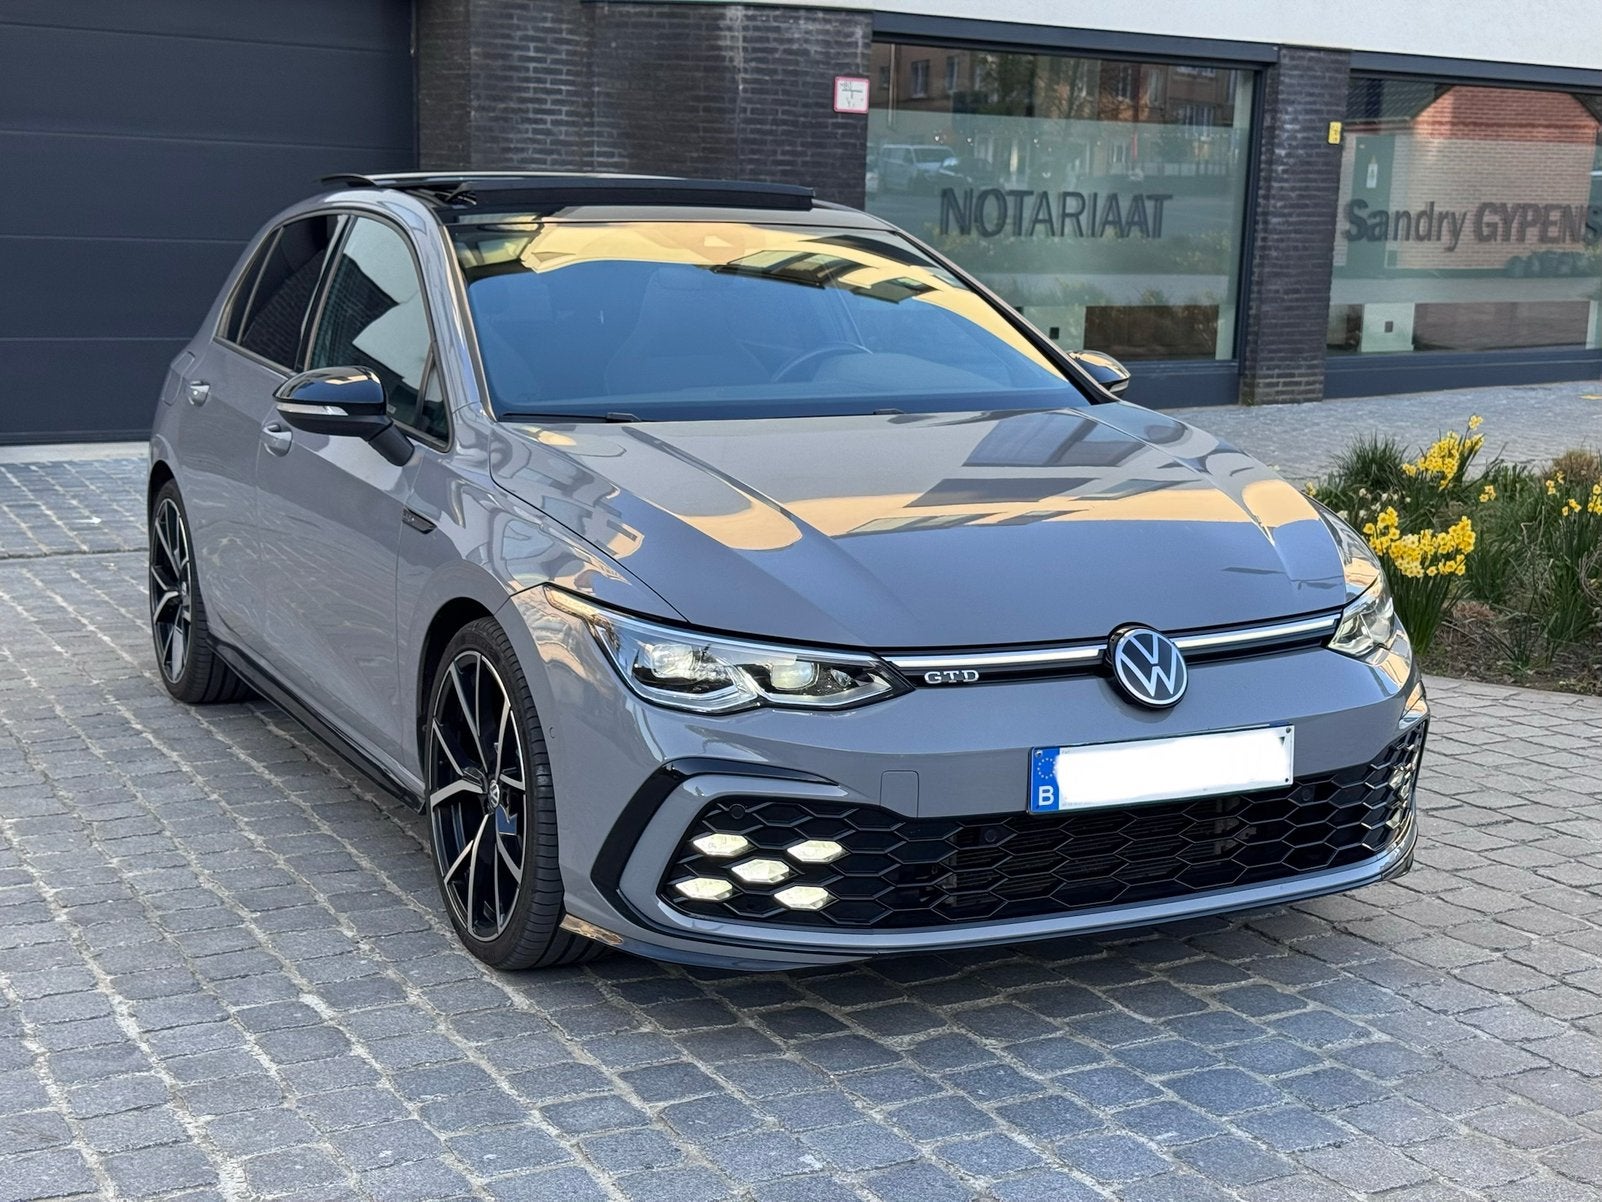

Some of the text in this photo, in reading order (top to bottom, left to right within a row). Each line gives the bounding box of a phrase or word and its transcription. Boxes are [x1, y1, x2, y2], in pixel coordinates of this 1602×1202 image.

[940, 186, 1174, 239] NOTARIAAT
[1342, 199, 1601, 252] Sandry GYPENS
[924, 669, 979, 684] GTD
[1117, 630, 1184, 701] VW
[1038, 785, 1055, 806] B
